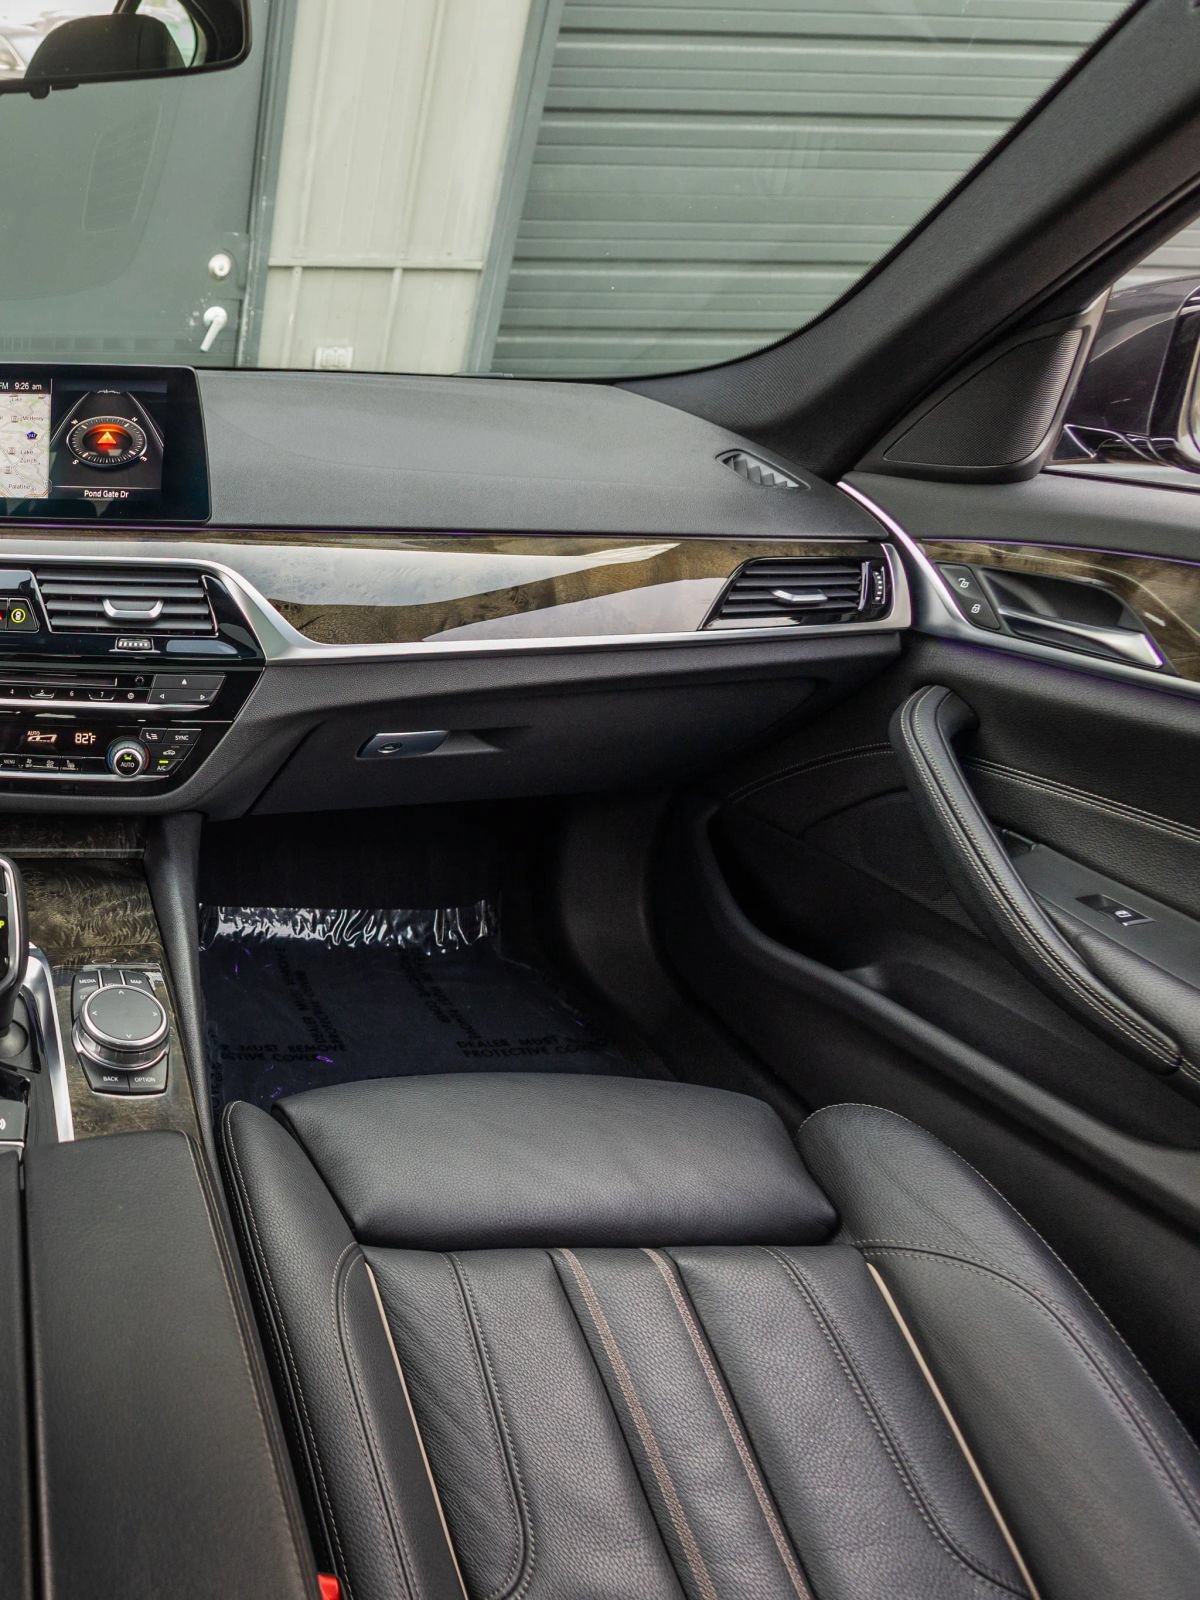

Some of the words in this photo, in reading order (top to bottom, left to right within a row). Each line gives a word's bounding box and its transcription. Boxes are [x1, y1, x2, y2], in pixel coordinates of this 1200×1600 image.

[14, 382, 29, 390] 9:26
[84, 489, 102, 498] Pond
[103, 490, 119, 498] Gate
[74, 732, 97, 744] 82°F
